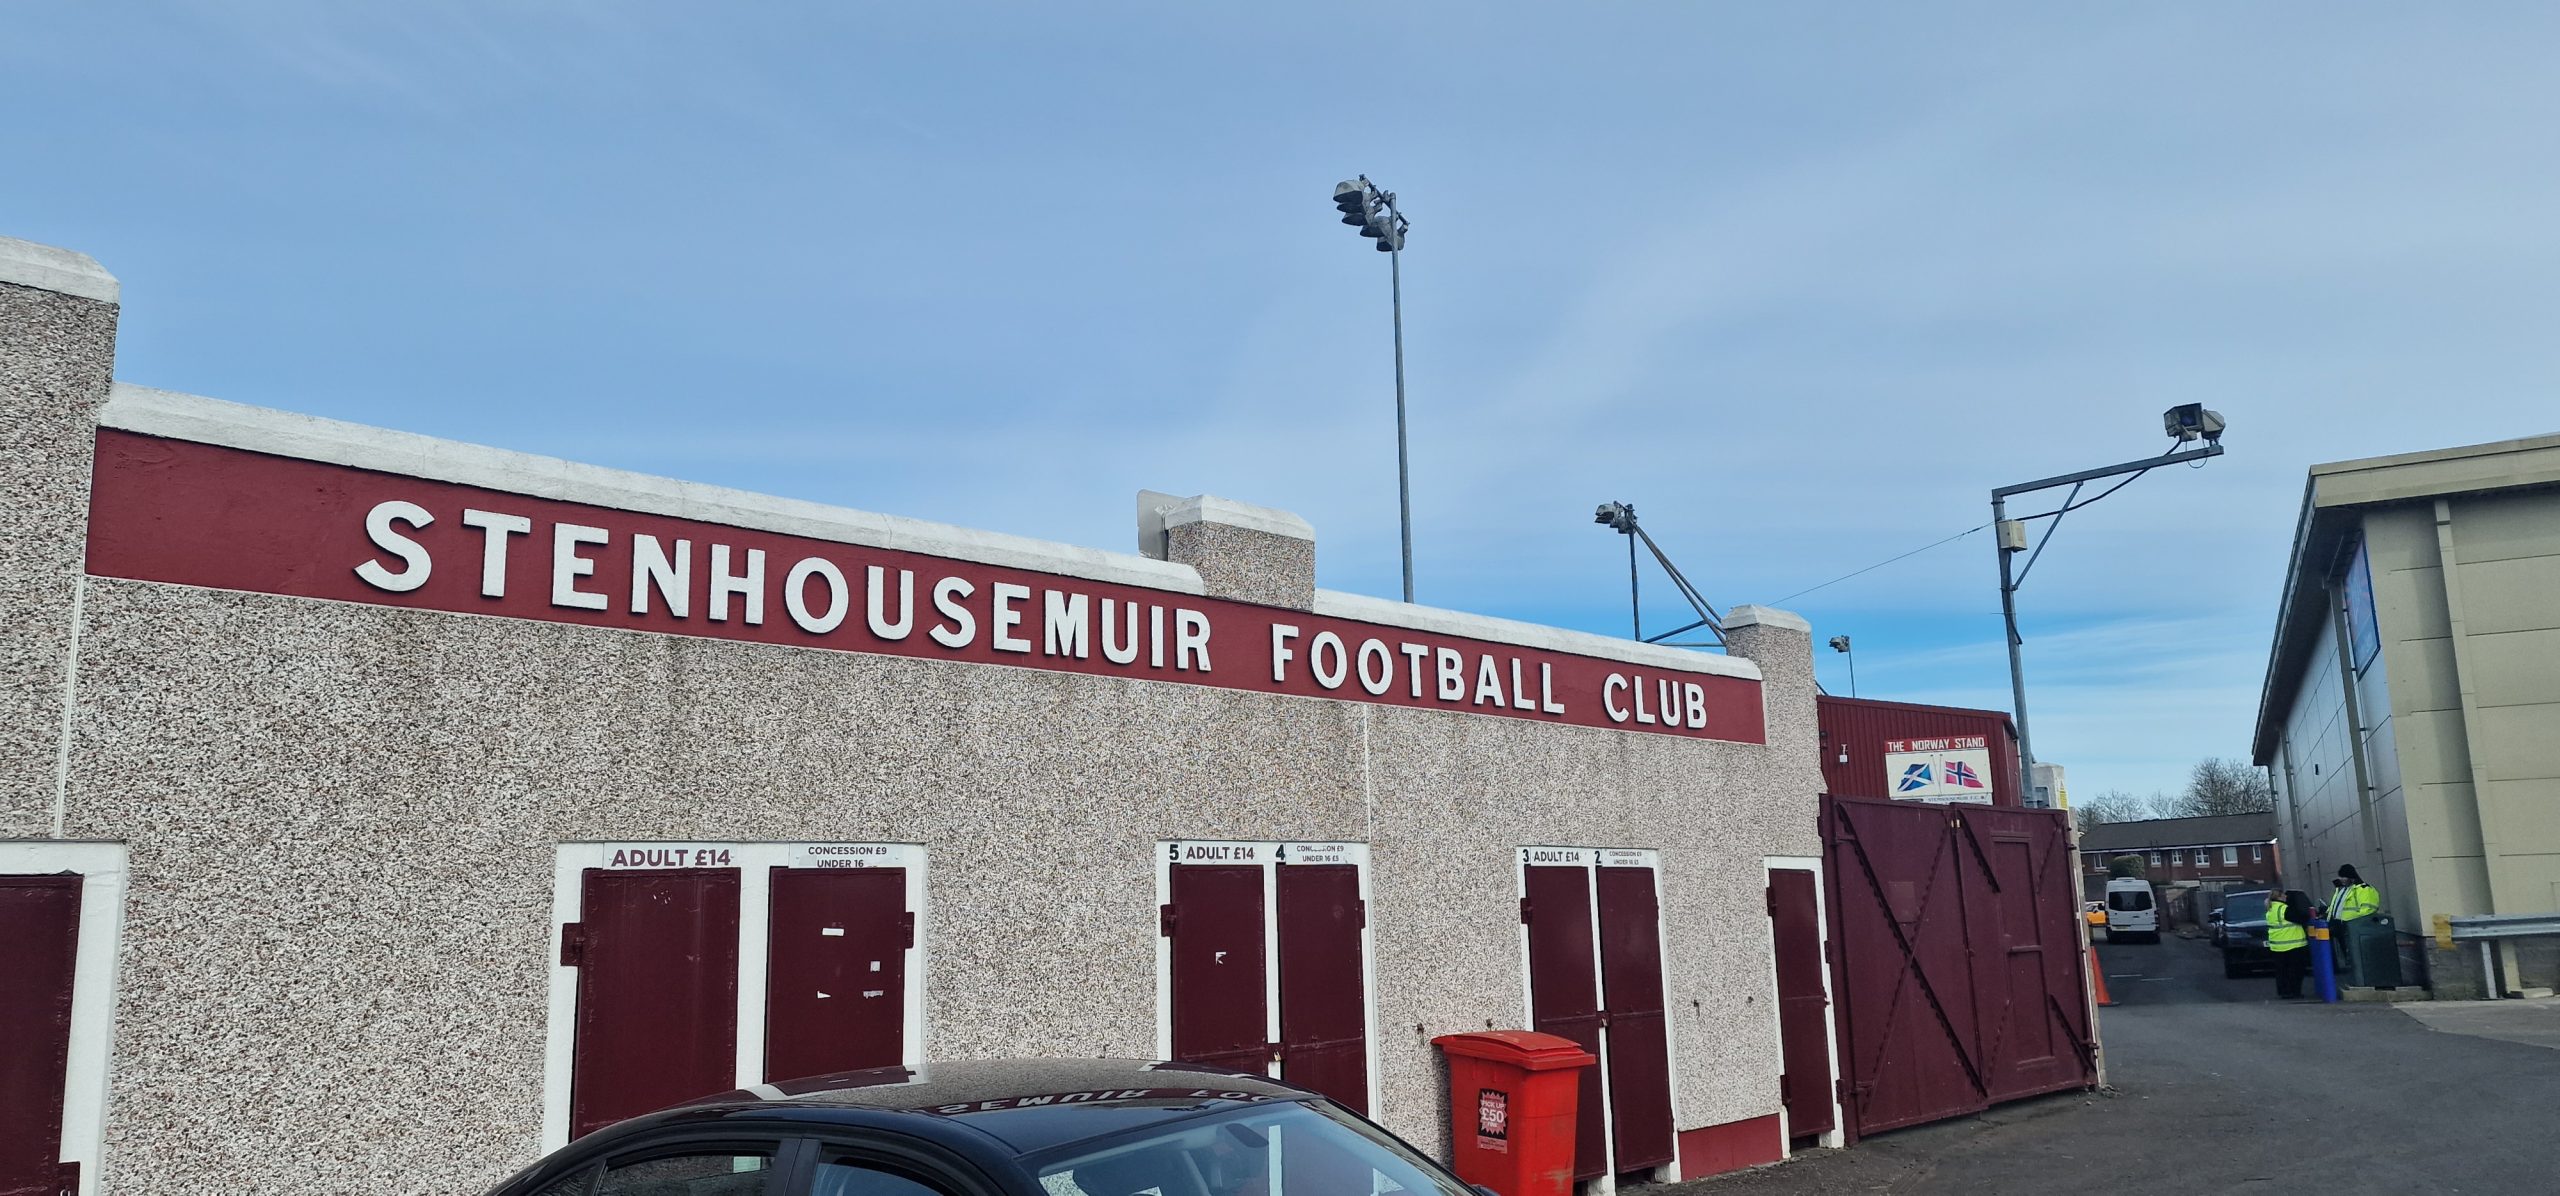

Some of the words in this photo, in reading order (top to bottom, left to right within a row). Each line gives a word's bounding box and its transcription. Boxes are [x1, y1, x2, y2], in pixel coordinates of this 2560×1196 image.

[353, 499, 1212, 672] STENHOUSEMUIR
[1271, 623, 1566, 715] FOOTBALL
[1602, 673, 1708, 729] CLUB
[1887, 741, 1905, 752] THE
[1911, 739, 1950, 751] NORWAY
[1955, 737, 1985, 749] STAND
[611, 849, 689, 867] ADULT
[694, 849, 731, 866] £14
[808, 846, 874, 856] CONCESSION
[875, 846, 888, 856] £9
[1169, 843, 1180, 861] 5
[1185, 846, 1231, 861] ADULT
[1233, 846, 1255, 860] £14
[1275, 843, 1286, 861] 4
[1522, 848, 1530, 863] 3
[1533, 851, 1563, 863] ADULT
[1565, 852, 1580, 863] £14
[1594, 850, 1602, 864] 2
[816, 859, 852, 868] UNDER
[854, 859, 865, 868] 16
[1482, 1107, 1505, 1123] £50
